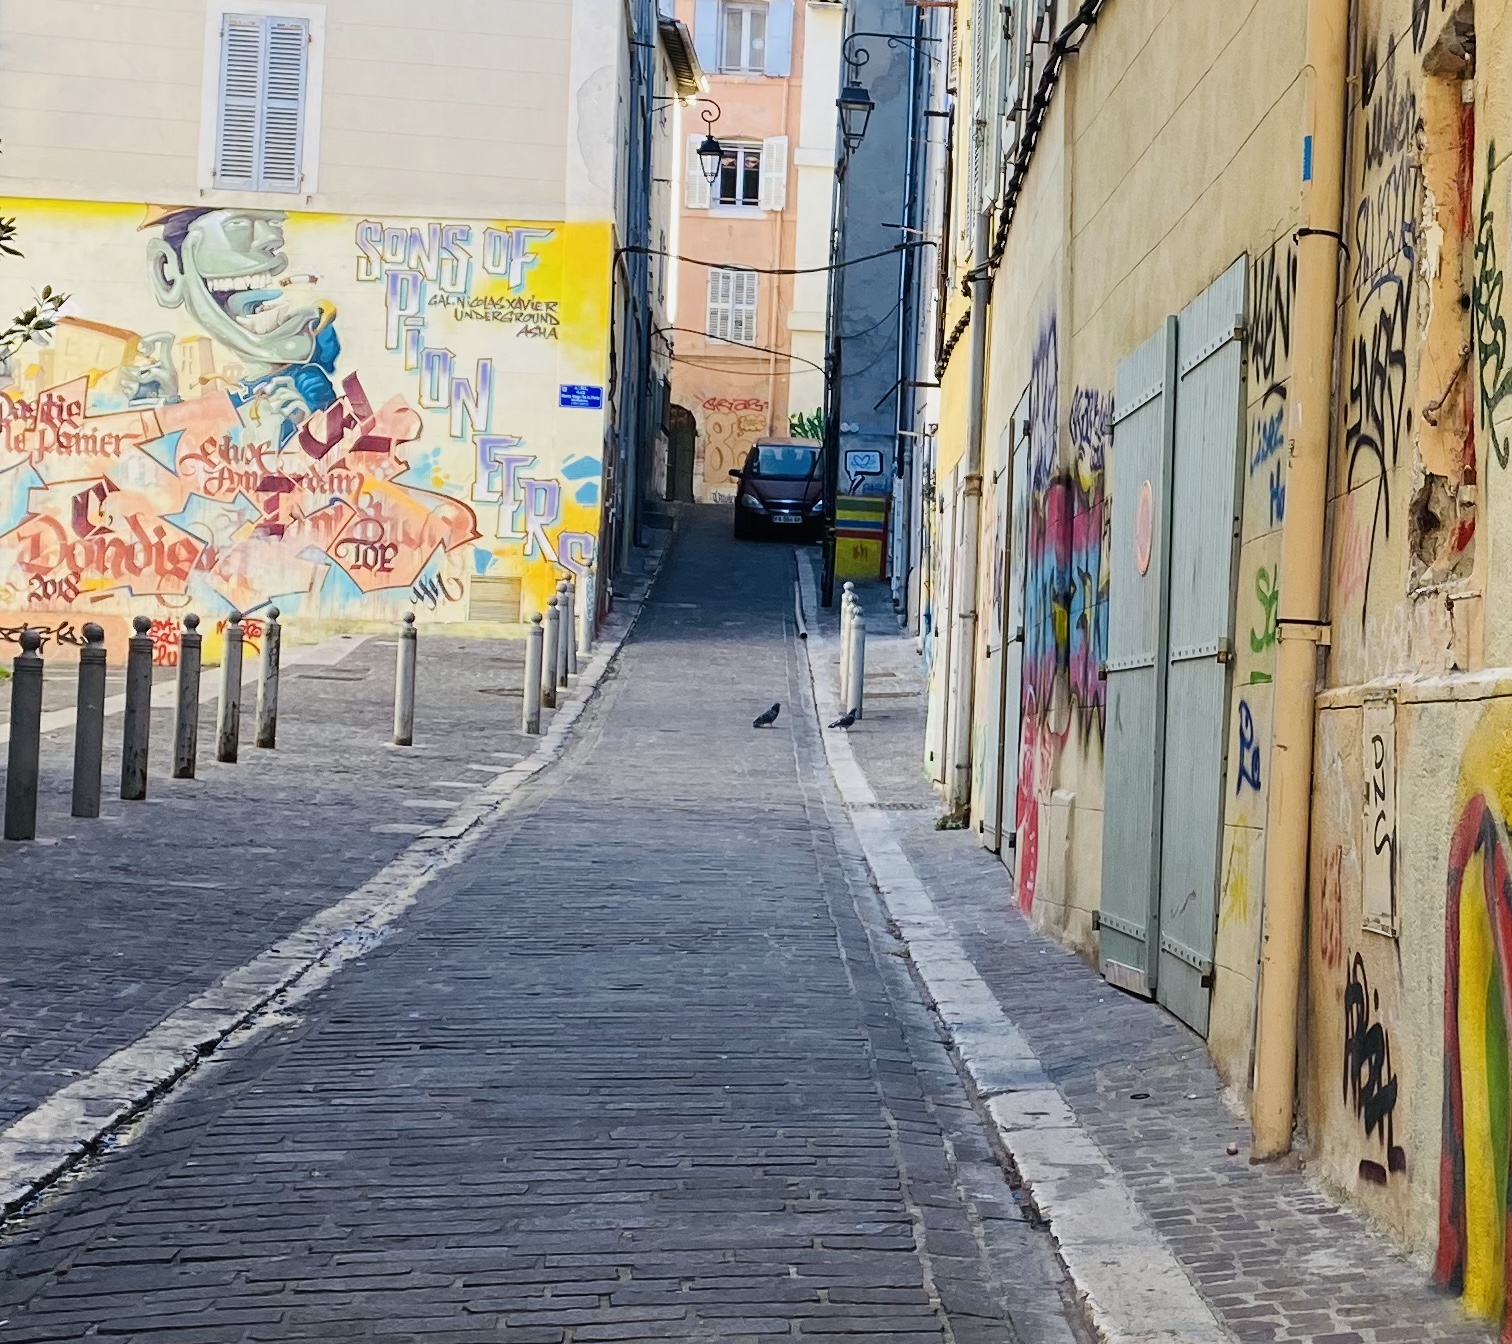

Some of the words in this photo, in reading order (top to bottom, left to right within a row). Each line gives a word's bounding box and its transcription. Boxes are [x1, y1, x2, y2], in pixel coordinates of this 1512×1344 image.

[355, 219, 474, 294] SONS
[482, 226, 556, 291] OF
[453, 307, 560, 326] UNDERGROUND
